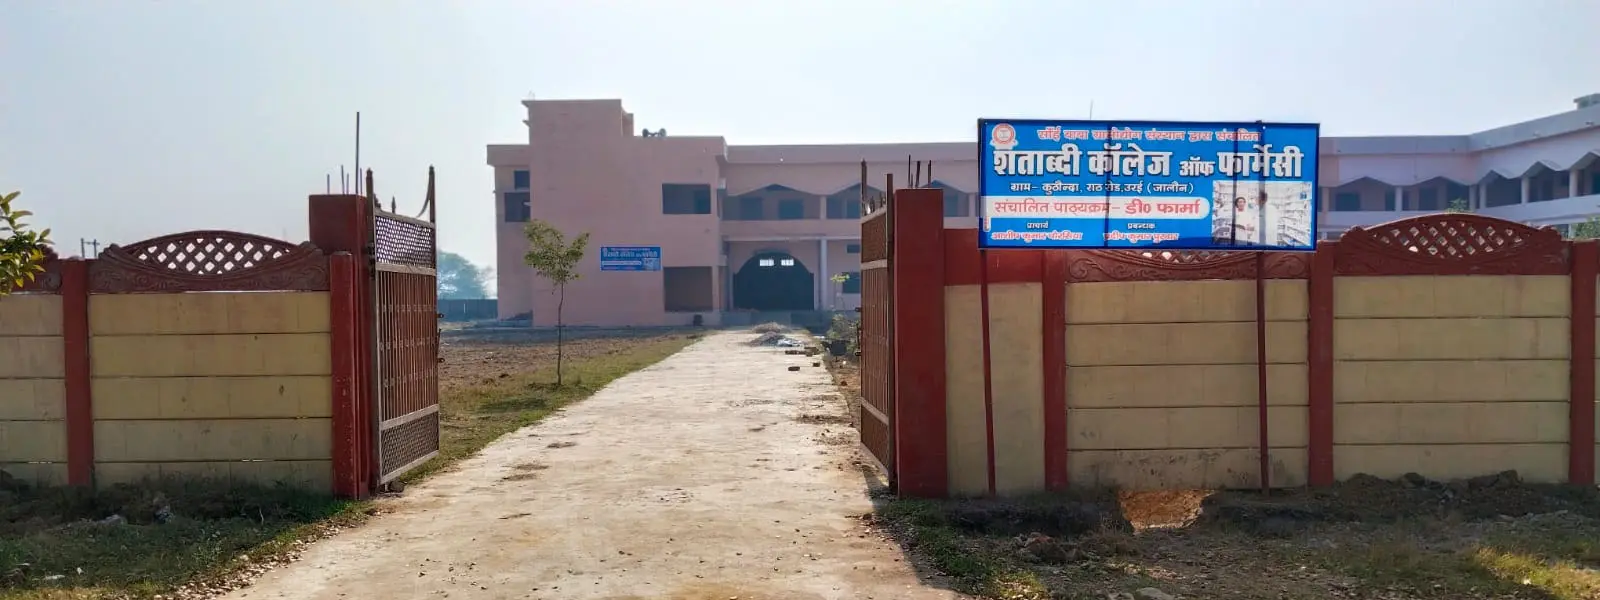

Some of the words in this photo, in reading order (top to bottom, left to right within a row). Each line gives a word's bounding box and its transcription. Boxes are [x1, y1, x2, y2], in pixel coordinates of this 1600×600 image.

[1144, 128, 1185, 141] संस्थान
[1188, 131, 1213, 142] द्वारा
[1215, 128, 1260, 141] संचालित
[993, 143, 1082, 175] शताब्दी
[1087, 143, 1172, 175] कॉलेज
[1179, 156, 1216, 176] ऑफ
[1217, 144, 1304, 177] फार्मेसी
[1086, 182, 1103, 192] राठ
[994, 198, 1049, 213] संचालित
[1157, 199, 1200, 214] फार्मा
